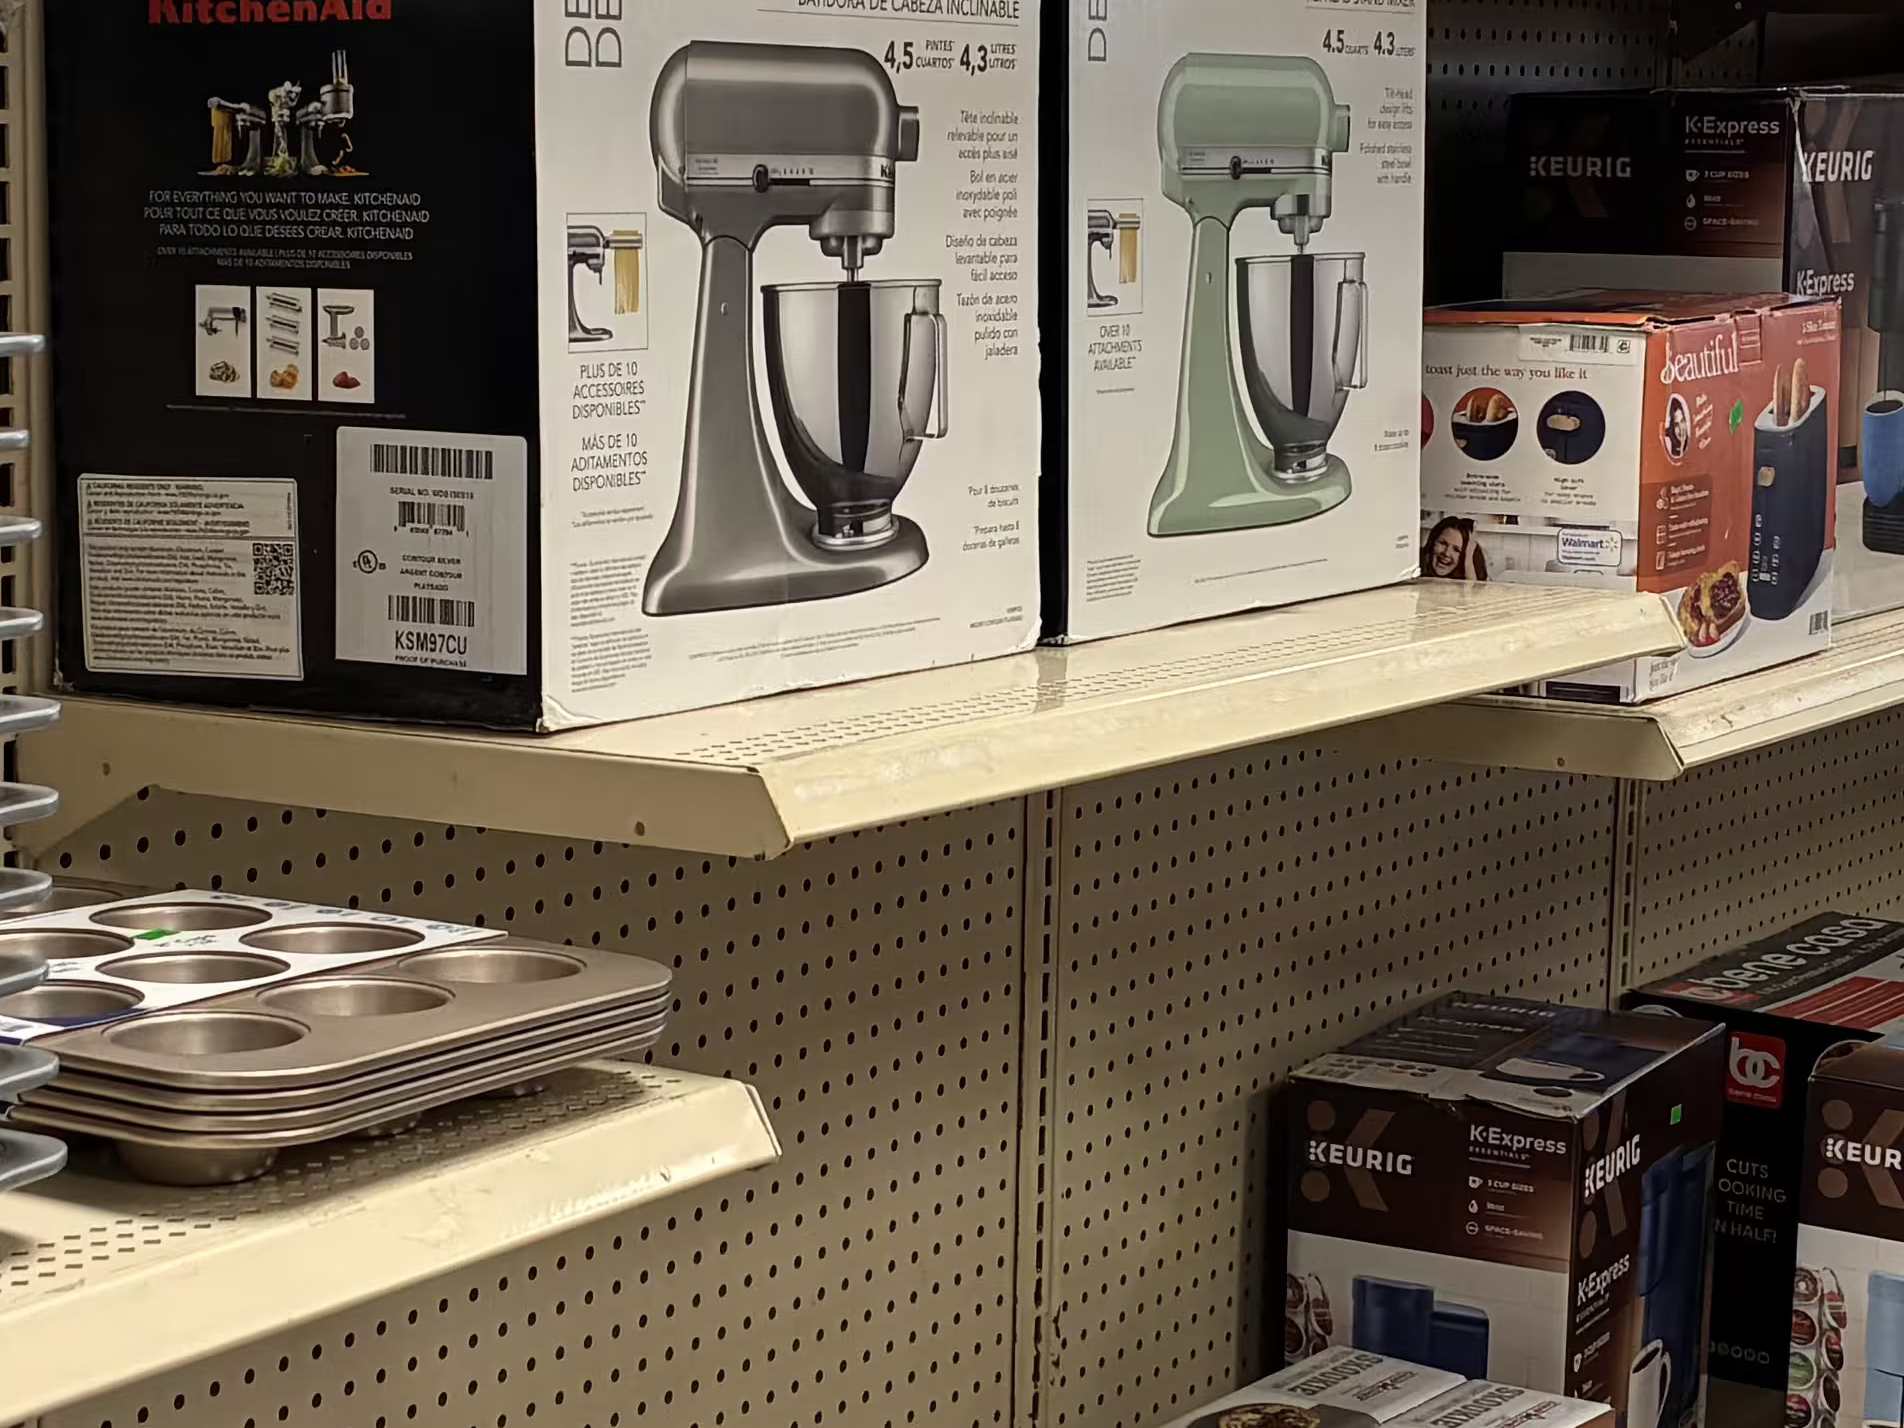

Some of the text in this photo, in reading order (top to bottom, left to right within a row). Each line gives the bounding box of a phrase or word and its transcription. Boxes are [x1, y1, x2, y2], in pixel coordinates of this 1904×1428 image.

[884, 41, 914, 73] 4,5
[960, 44, 988, 76] 4,3
[1530, 155, 1631, 178] KEURIG
[1803, 150, 1874, 183] KEURIG
[149, 191, 171, 204] FOR
[173, 191, 237, 204] EVERYTHING
[240, 192, 263, 204] YOU
[265, 192, 299, 204] WANT
[301, 192, 315, 204] TO
[354, 193, 421, 206] KITCHENAID
[580, 361, 637, 379] PLUS DE 10
[1425, 364, 1587, 380] toast just the way you like it
[573, 380, 644, 399] ACCESSOIRES
[1562, 537, 1604, 549] Walmart
[395, 630, 467, 655] KSM97CU
[1688, 917, 1888, 990] bene casa
[1308, 1140, 1413, 1175] KEURIG
[1584, 1134, 1641, 1198] KEURIG
[1726, 1158, 1769, 1179] CUTS
[1718, 1178, 1786, 1203] OOKING
[1727, 1200, 1764, 1220] TIME
[1431, 1386, 1524, 1428] SKOOKIE
